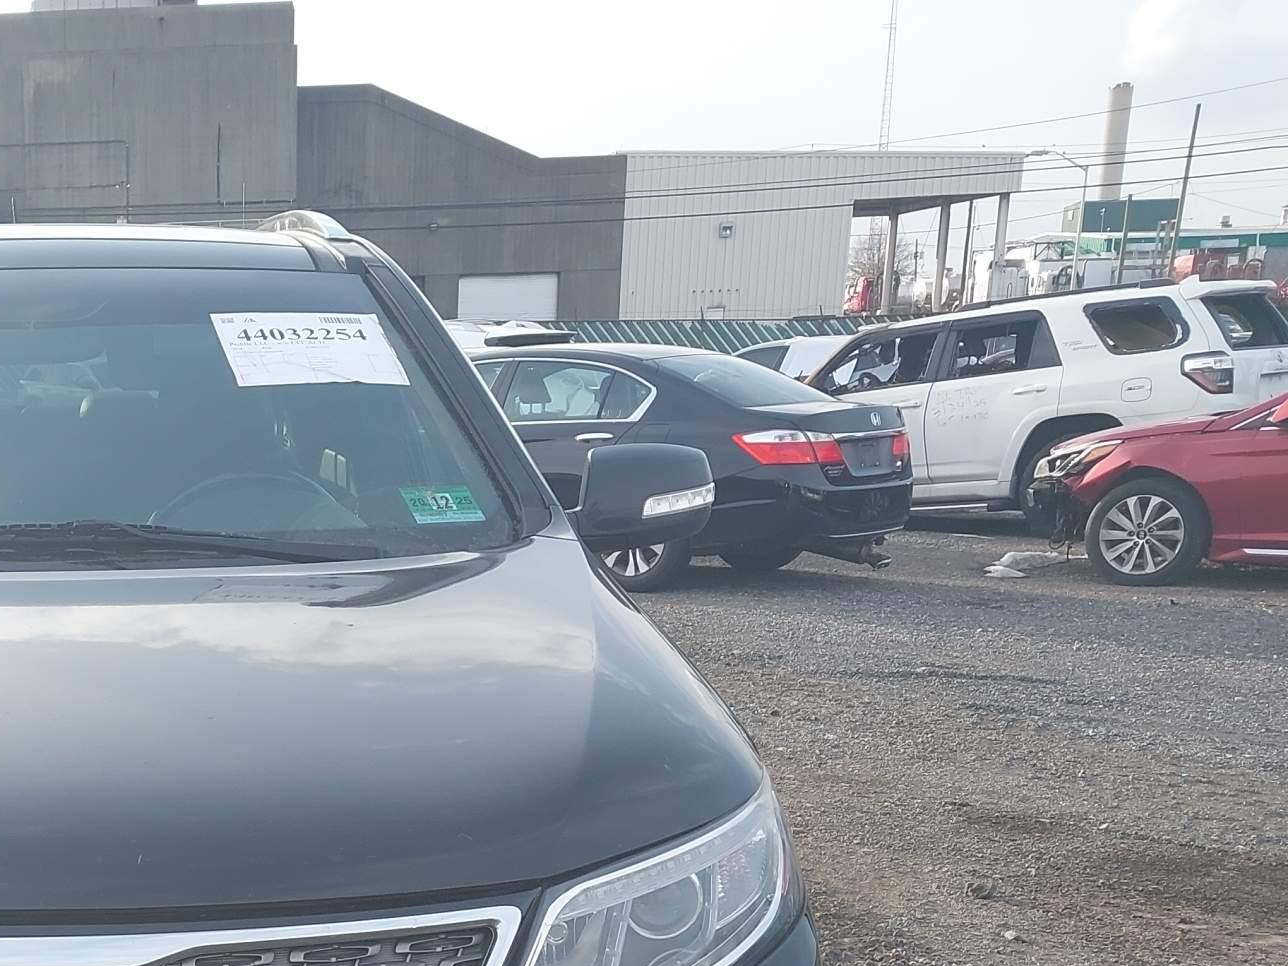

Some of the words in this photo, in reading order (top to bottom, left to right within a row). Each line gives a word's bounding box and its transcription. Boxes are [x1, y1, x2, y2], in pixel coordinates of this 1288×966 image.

[237, 328, 367, 341] 44032254
[431, 495, 454, 509] 12
[455, 496, 472, 505] 25
